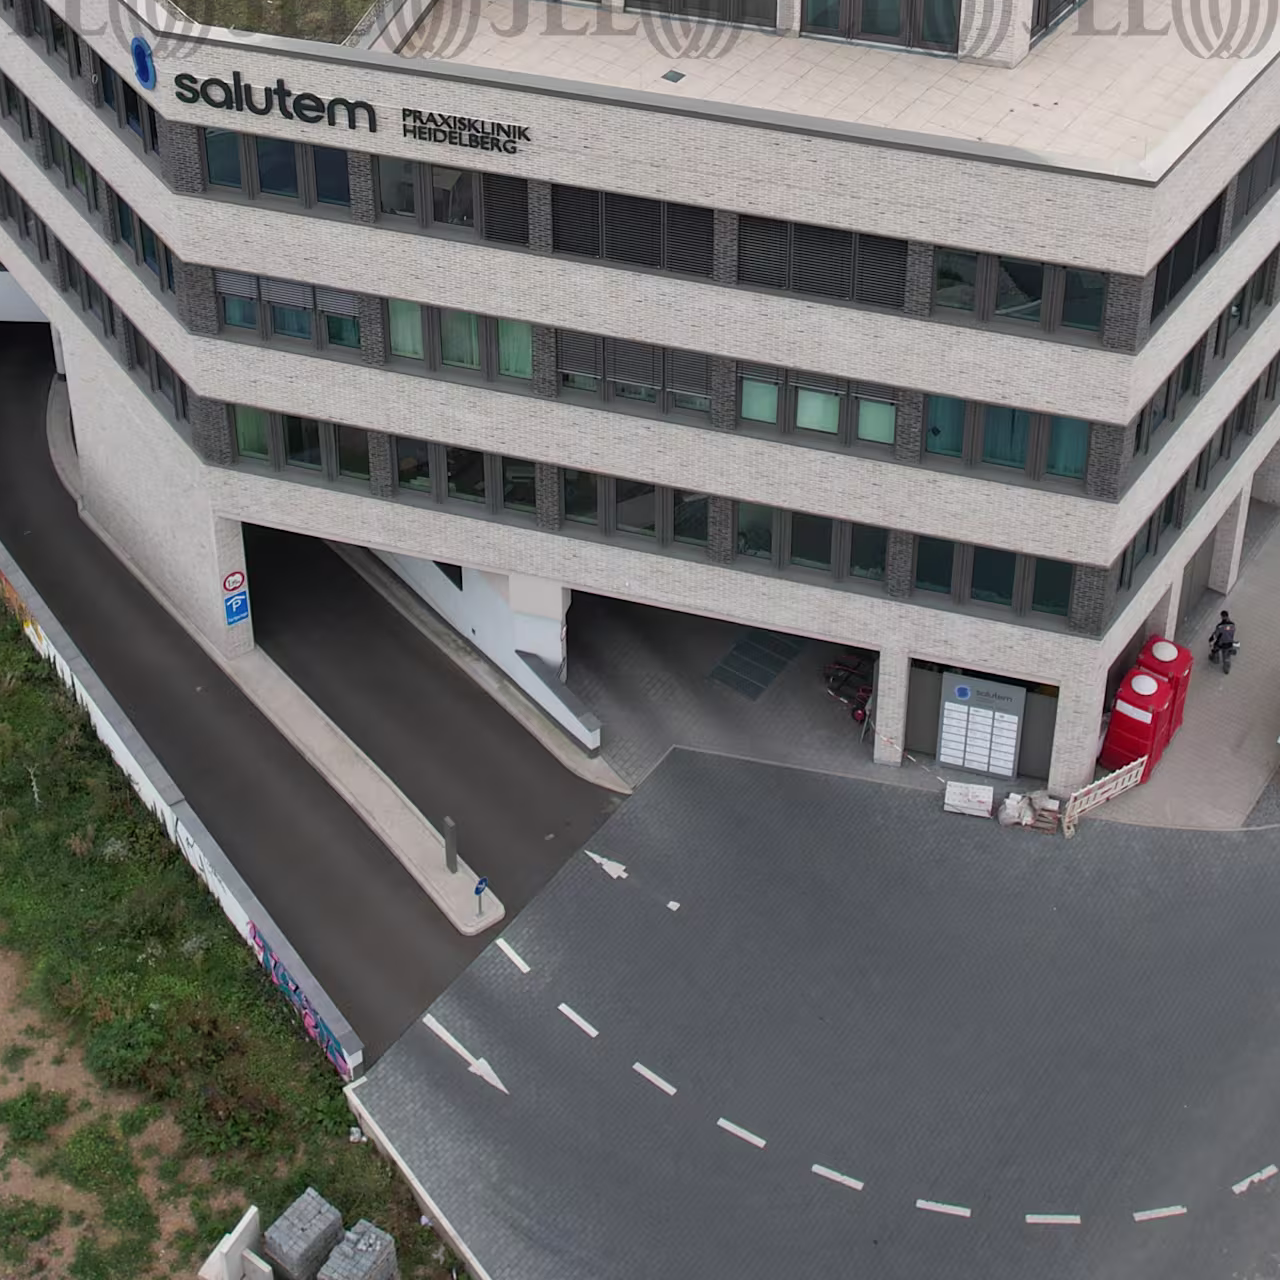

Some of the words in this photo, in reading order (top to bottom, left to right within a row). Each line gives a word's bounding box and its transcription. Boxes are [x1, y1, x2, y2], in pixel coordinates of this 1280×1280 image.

[174, 71, 377, 133] salutem
[402, 107, 531, 143] PRAXISKLINIK
[402, 123, 518, 155] HEIDELBERG
